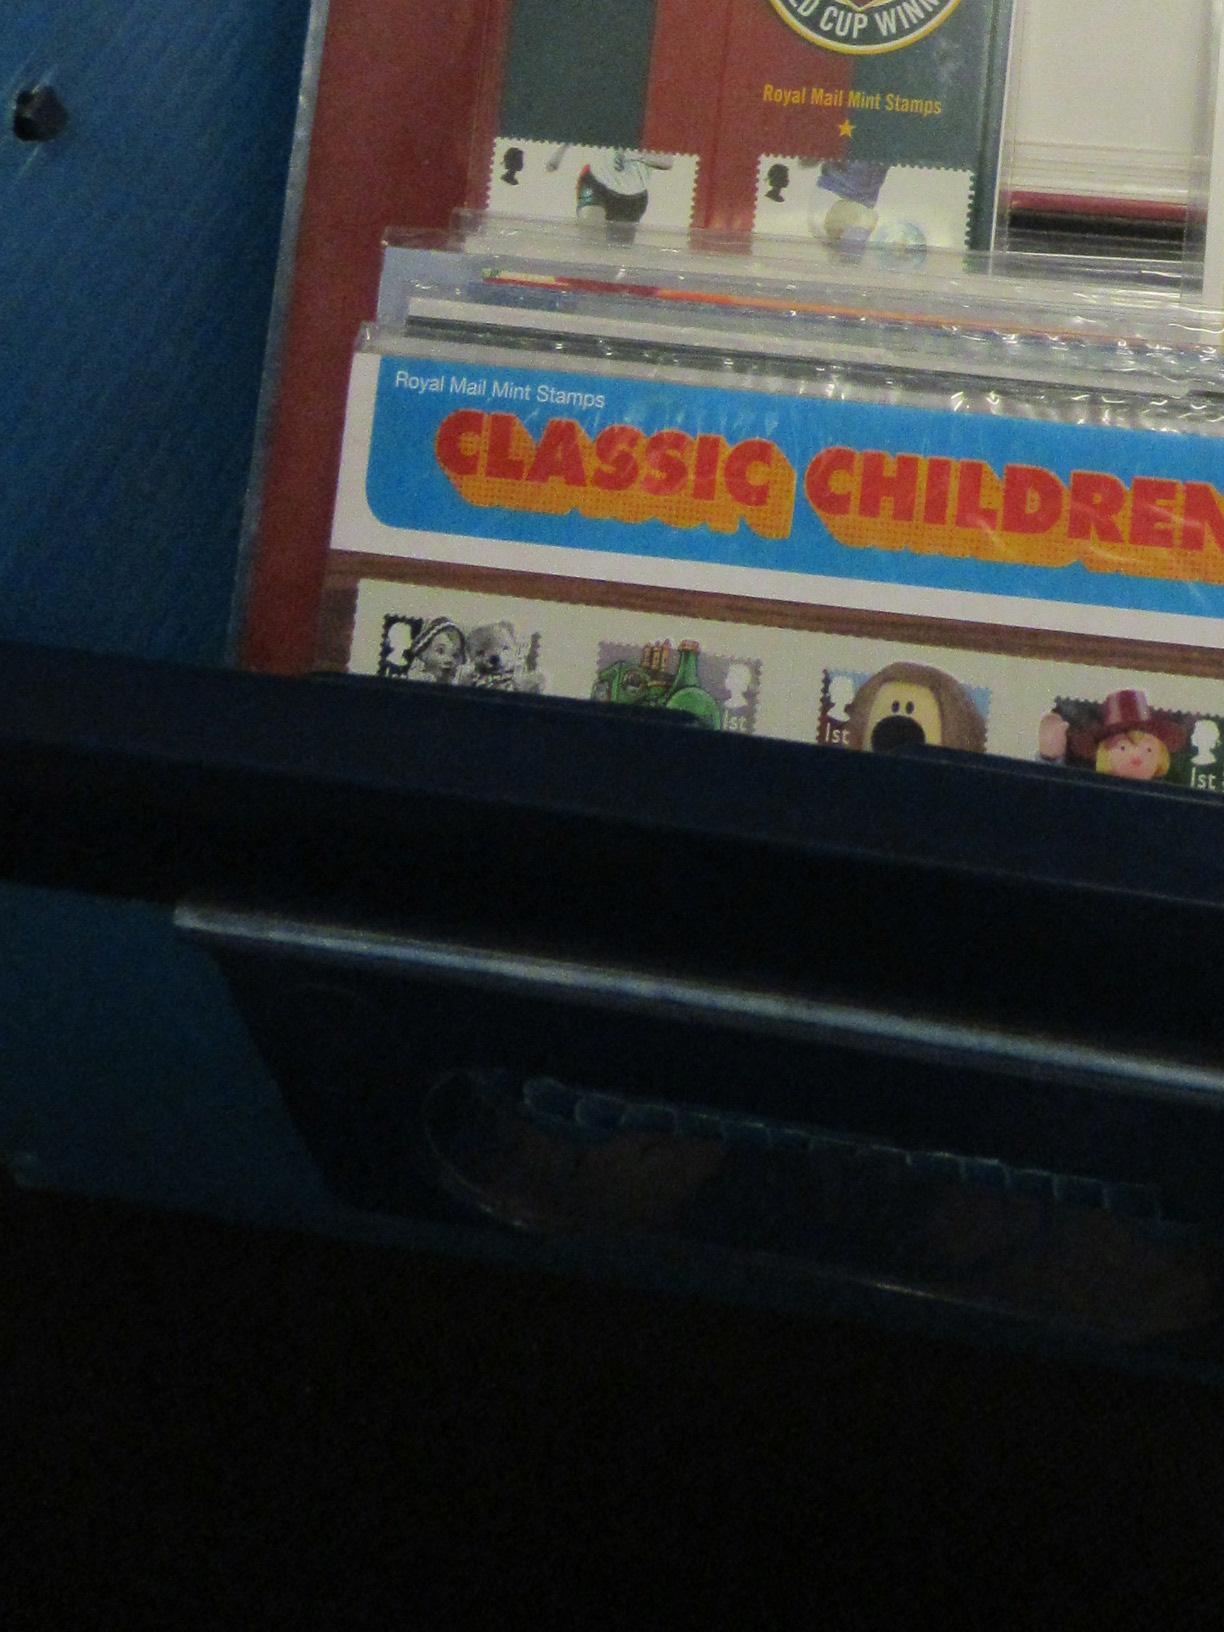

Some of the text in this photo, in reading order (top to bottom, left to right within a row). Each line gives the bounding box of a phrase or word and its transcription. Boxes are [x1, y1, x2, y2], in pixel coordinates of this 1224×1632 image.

[819, 5, 869, 39] CUP
[761, 82, 943, 118] Royal Mail Mint Stamps
[394, 369, 606, 410] Royal Mail Mint Stamps
[434, 406, 792, 536] CLASSIC
[723, 709, 747, 730] 1st
[825, 721, 850, 745] 1st
[1190, 765, 1217, 790] 1st
